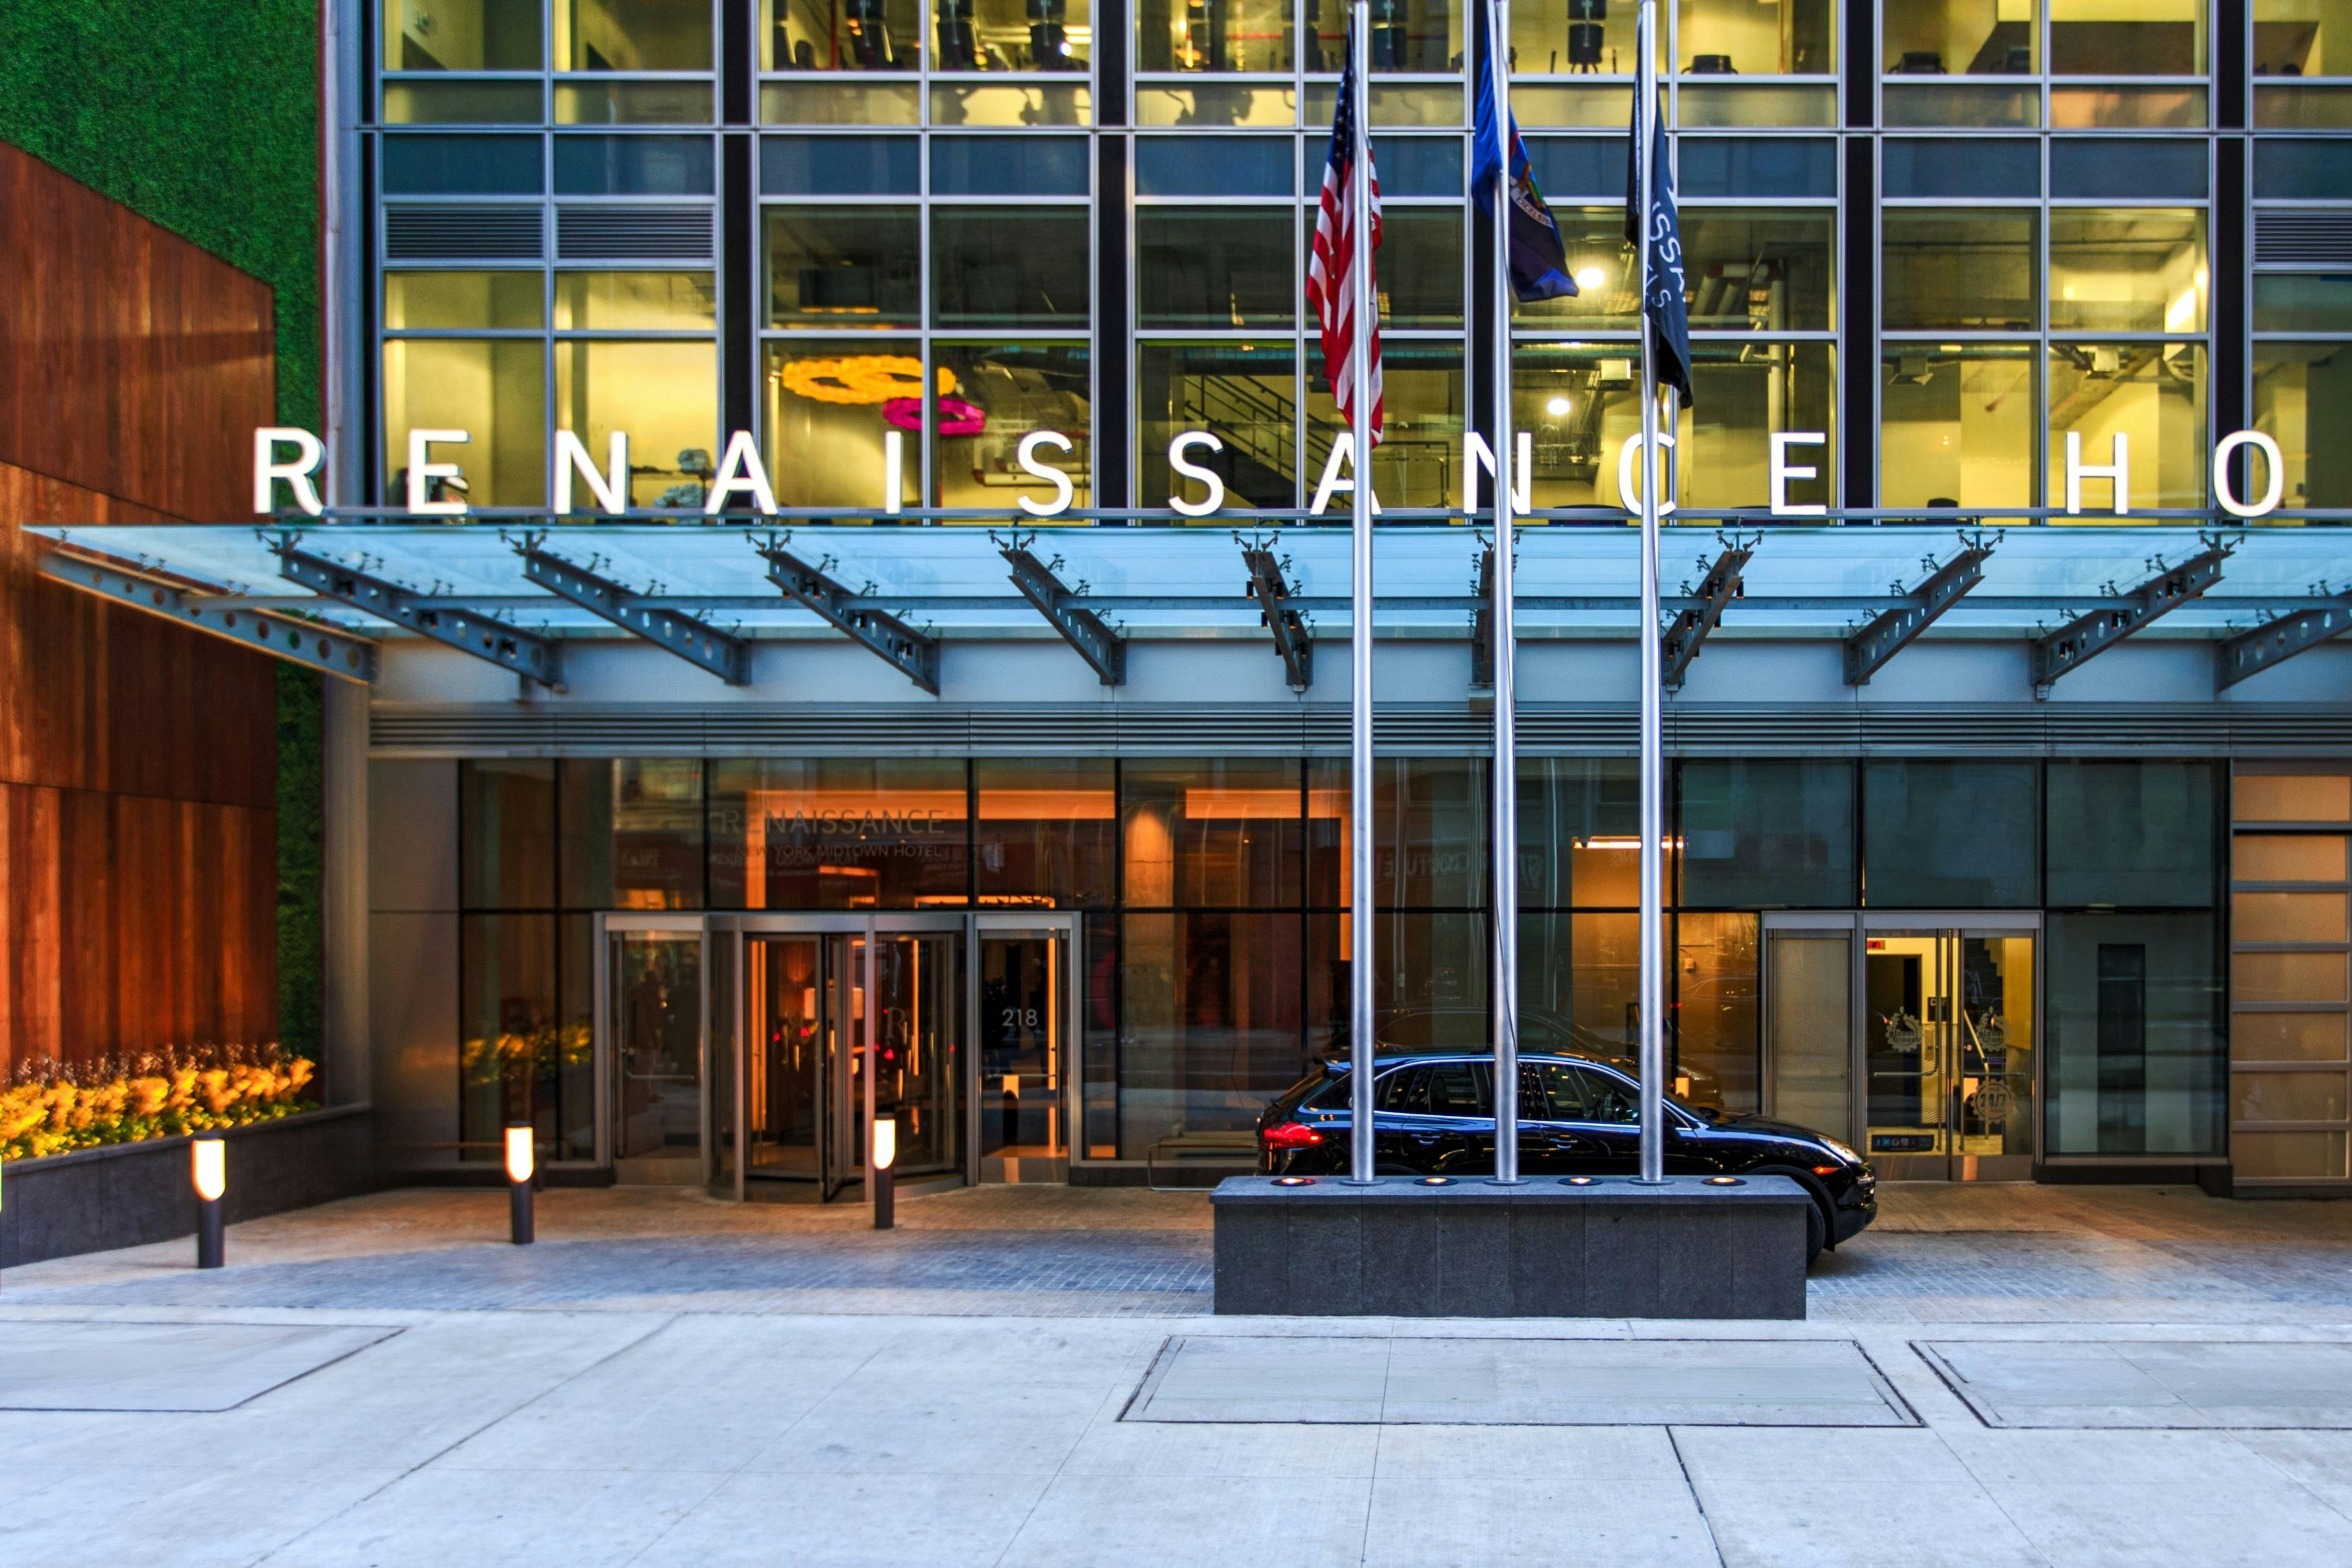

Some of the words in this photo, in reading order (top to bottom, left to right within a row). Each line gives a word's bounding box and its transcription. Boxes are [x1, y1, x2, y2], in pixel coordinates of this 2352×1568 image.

[254, 426, 1826, 517] RENAISSANCE
[774, 845, 812, 857] YORK
[817, 845, 889, 858] MIDTOWN
[894, 845, 941, 858] HOTEL
[1002, 1008, 1038, 1027] 218
